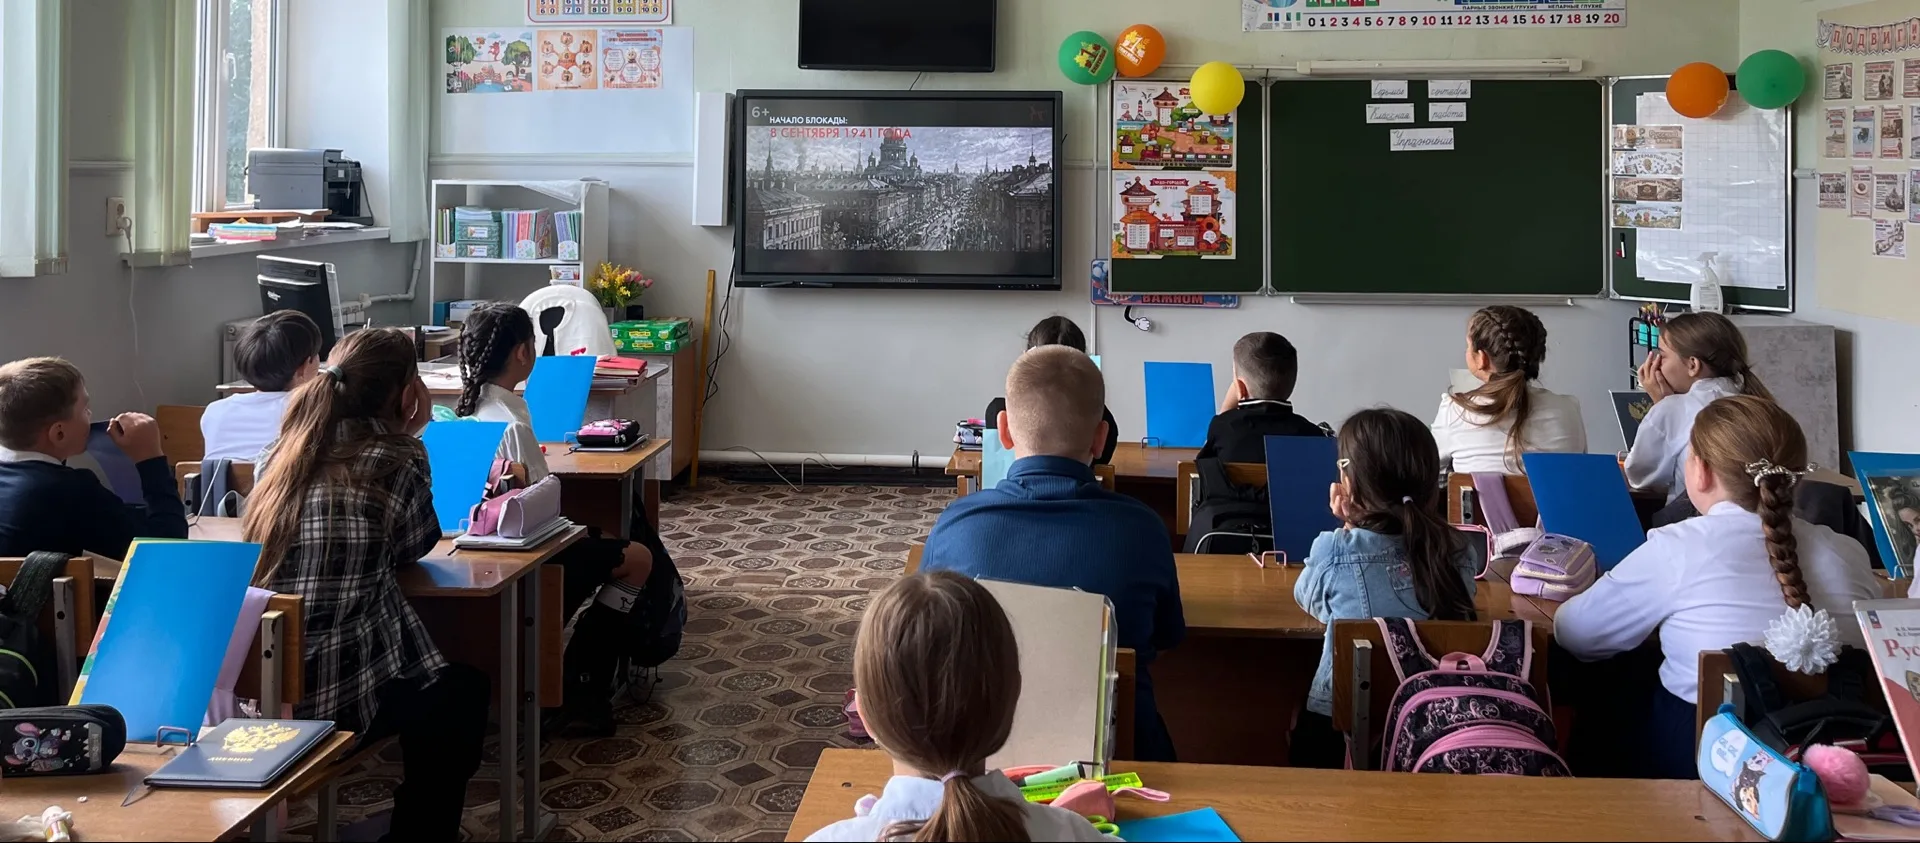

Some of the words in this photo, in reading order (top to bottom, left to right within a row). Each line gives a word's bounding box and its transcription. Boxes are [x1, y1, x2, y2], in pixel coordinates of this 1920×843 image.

[1308, 18, 1316, 27] 0
[1320, 18, 1326, 27] 1
[1330, 17, 1338, 27] 2
[1341, 17, 1349, 27] 3
[1352, 17, 1361, 27] 4
[1364, 17, 1372, 26] 5
[1376, 17, 1384, 26] 6
[1387, 16, 1395, 26] 7
[1399, 16, 1407, 26] 8
[1411, 16, 1419, 26] 9
[1422, 16, 1437, 26] 10
[1440, 15, 1453, 26] 11
[1457, 15, 1472, 25] 12
[1475, 15, 1490, 25] 13
[1493, 15, 1509, 25] 14
[1513, 15, 1527, 24] 15
[1531, 14, 1546, 24] 16
[1550, 14, 1564, 24] 17
[1567, 14, 1582, 24] 18
[1585, 14, 1600, 24] 19
[1604, 14, 1620, 24] 20
[1833, 28, 1903, 48] ПОДВИГ
[1430, 82, 1468, 98] сентября
[751, 106, 770, 118] 6+
[1369, 107, 1410, 120] Классная
[1431, 104, 1464, 120] работа
[805, 117, 848, 125] БЛОКАДЫ:
[770, 128, 777, 138] 8
[781, 128, 840, 138] СЕНТЯБРЯ
[845, 128, 873, 138] 1941
[877, 128, 912, 138] ГОДА
[1649, 130, 1679, 138] Русский
[1392, 130, 1454, 150] Упражнение
